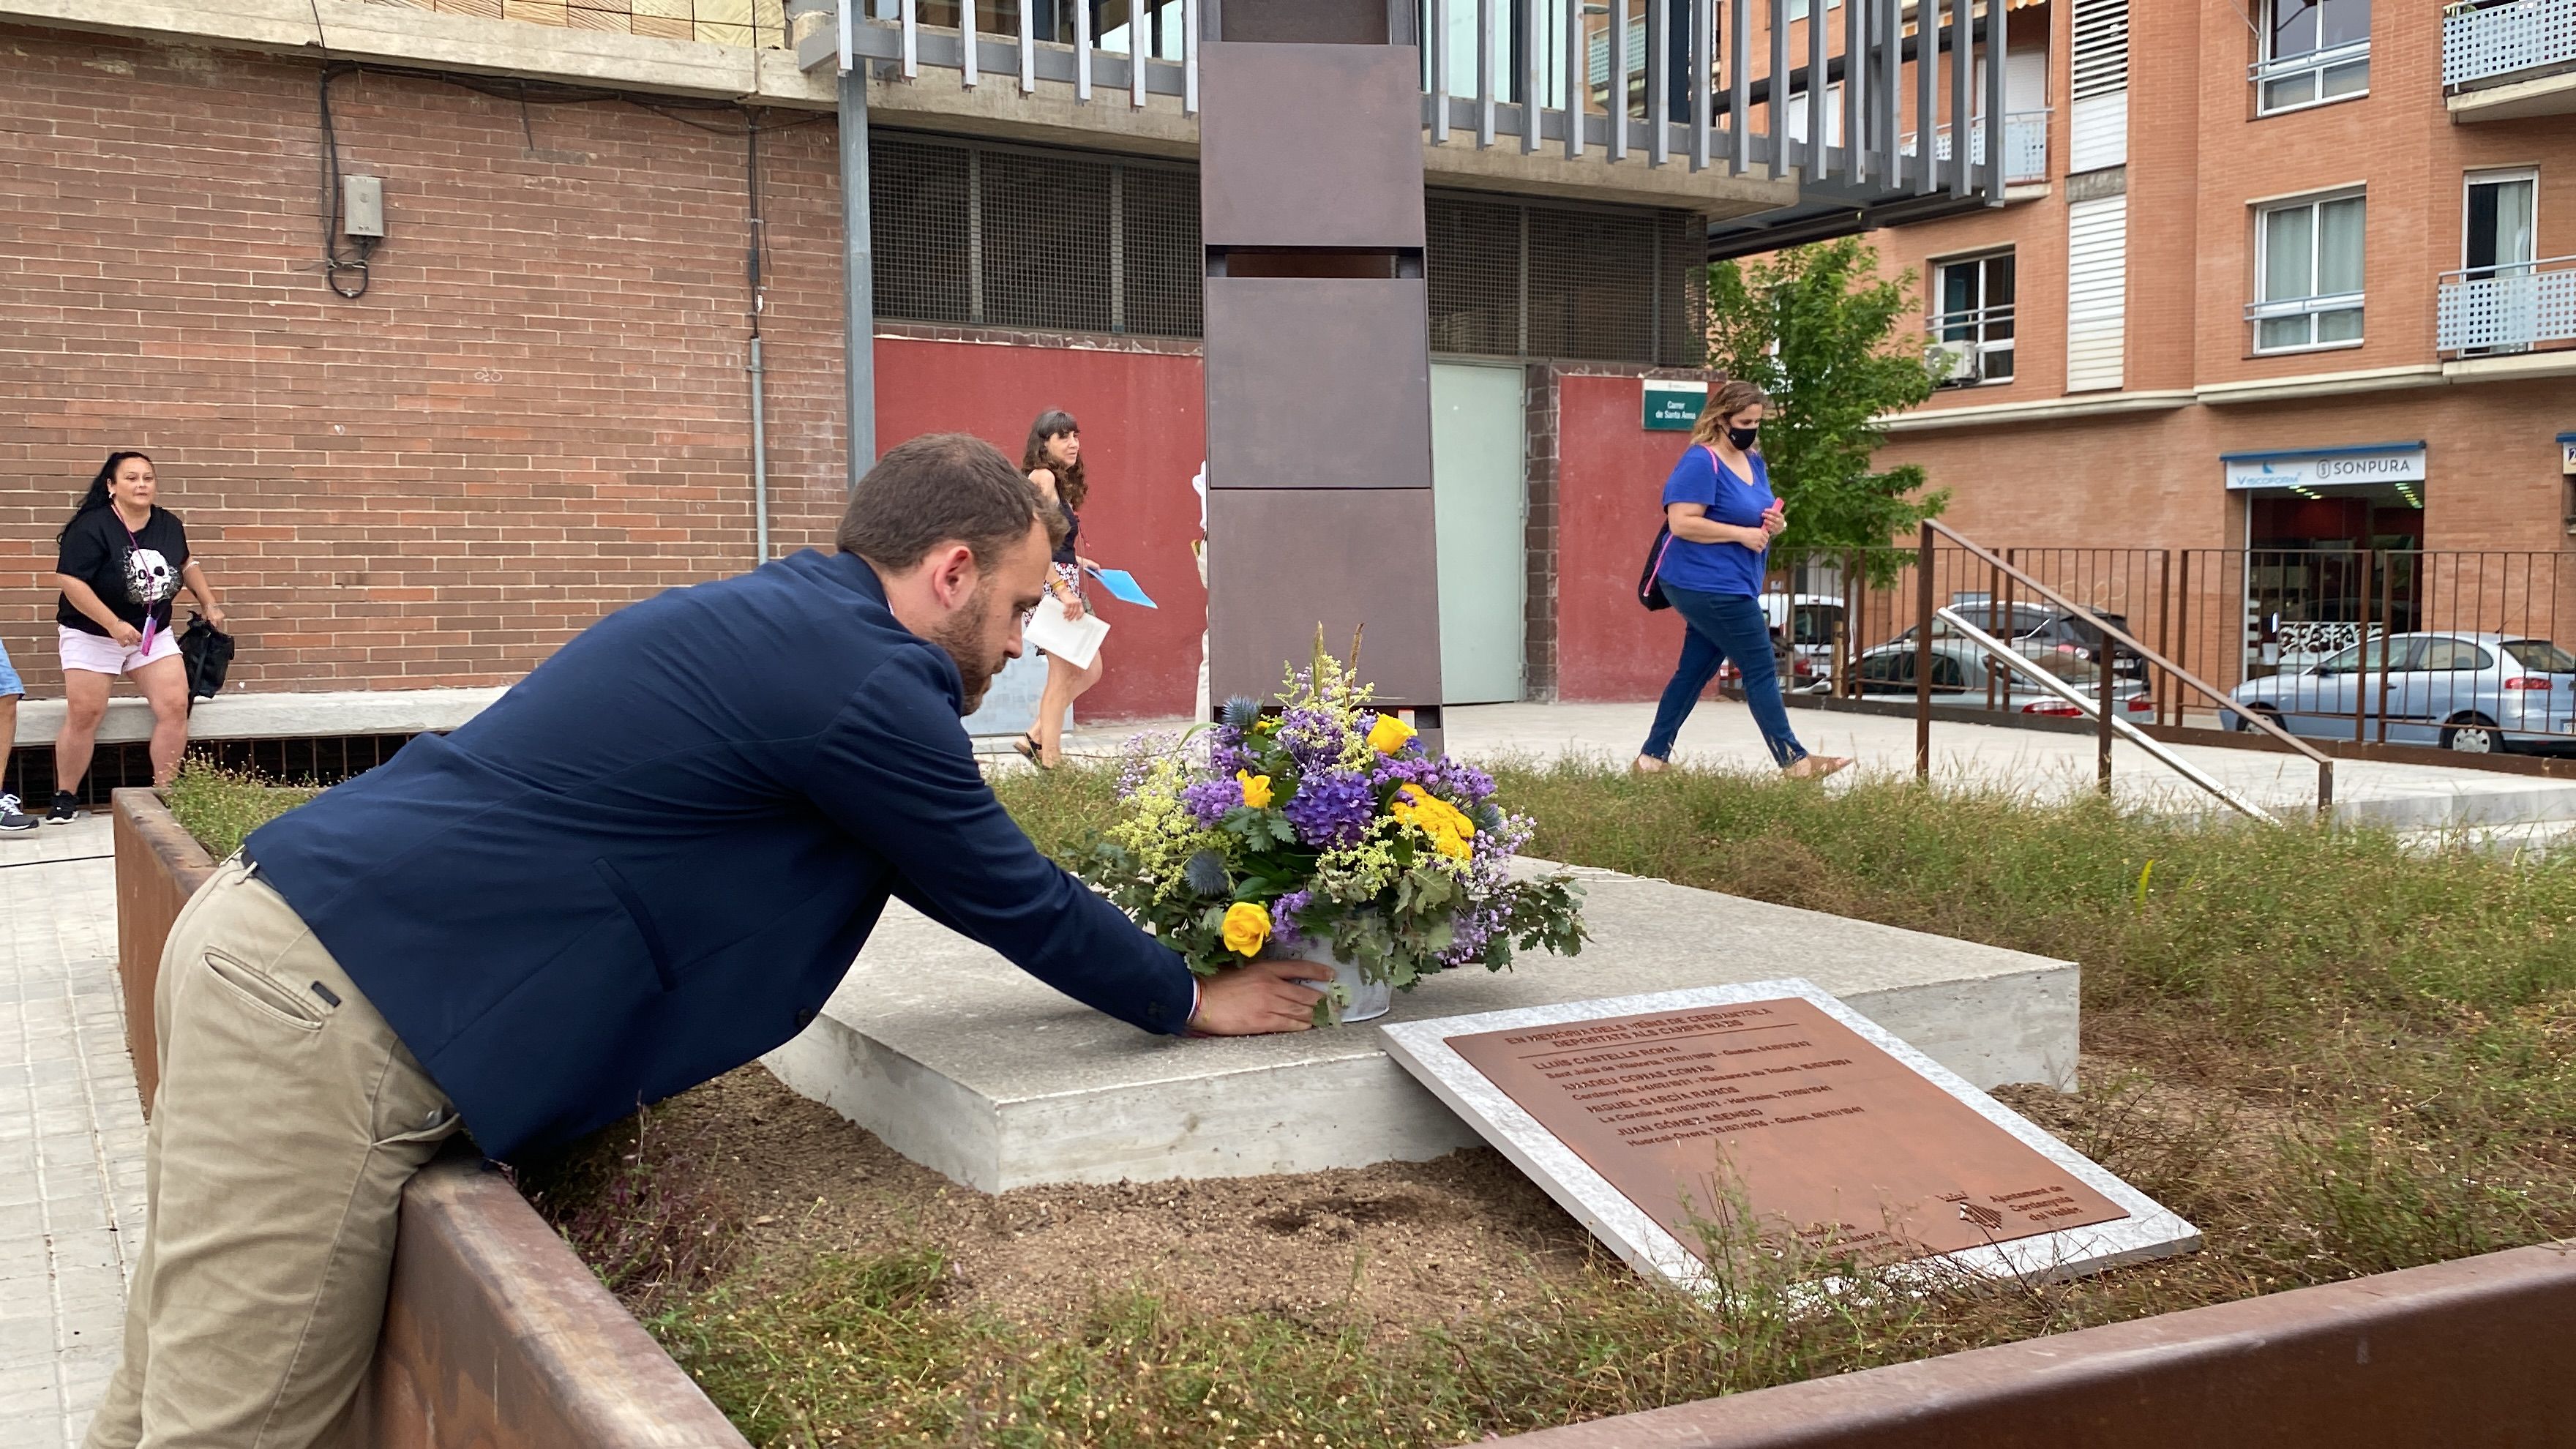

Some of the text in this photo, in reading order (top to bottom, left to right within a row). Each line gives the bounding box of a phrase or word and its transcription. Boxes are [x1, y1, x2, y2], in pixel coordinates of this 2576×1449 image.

[1655, 410, 1663, 419] de
[1664, 410, 1681, 419] Santa
[2334, 460, 2410, 475] SONPURA
[1590, 1025, 1627, 1034] DELS
[1687, 1008, 1774, 1023] CERDANYOLA
[1552, 1019, 1744, 1048] DEPORTATS ALS CAMPS NAZIS
[1573, 1051, 1640, 1065] CASTELLS
[1562, 1065, 1715, 1091] AMADEU COMAS COMAS
[1586, 1086, 1740, 1114] MIGUEL GARCÍA RAMOS
[1617, 1109, 1764, 1136] JUAN GÓMEZ ASENSIO
[1989, 1188, 2050, 1202] Ajuntament
[2009, 1197, 2074, 1211] Cerdanyola
[2029, 1212, 2049, 1221] del
